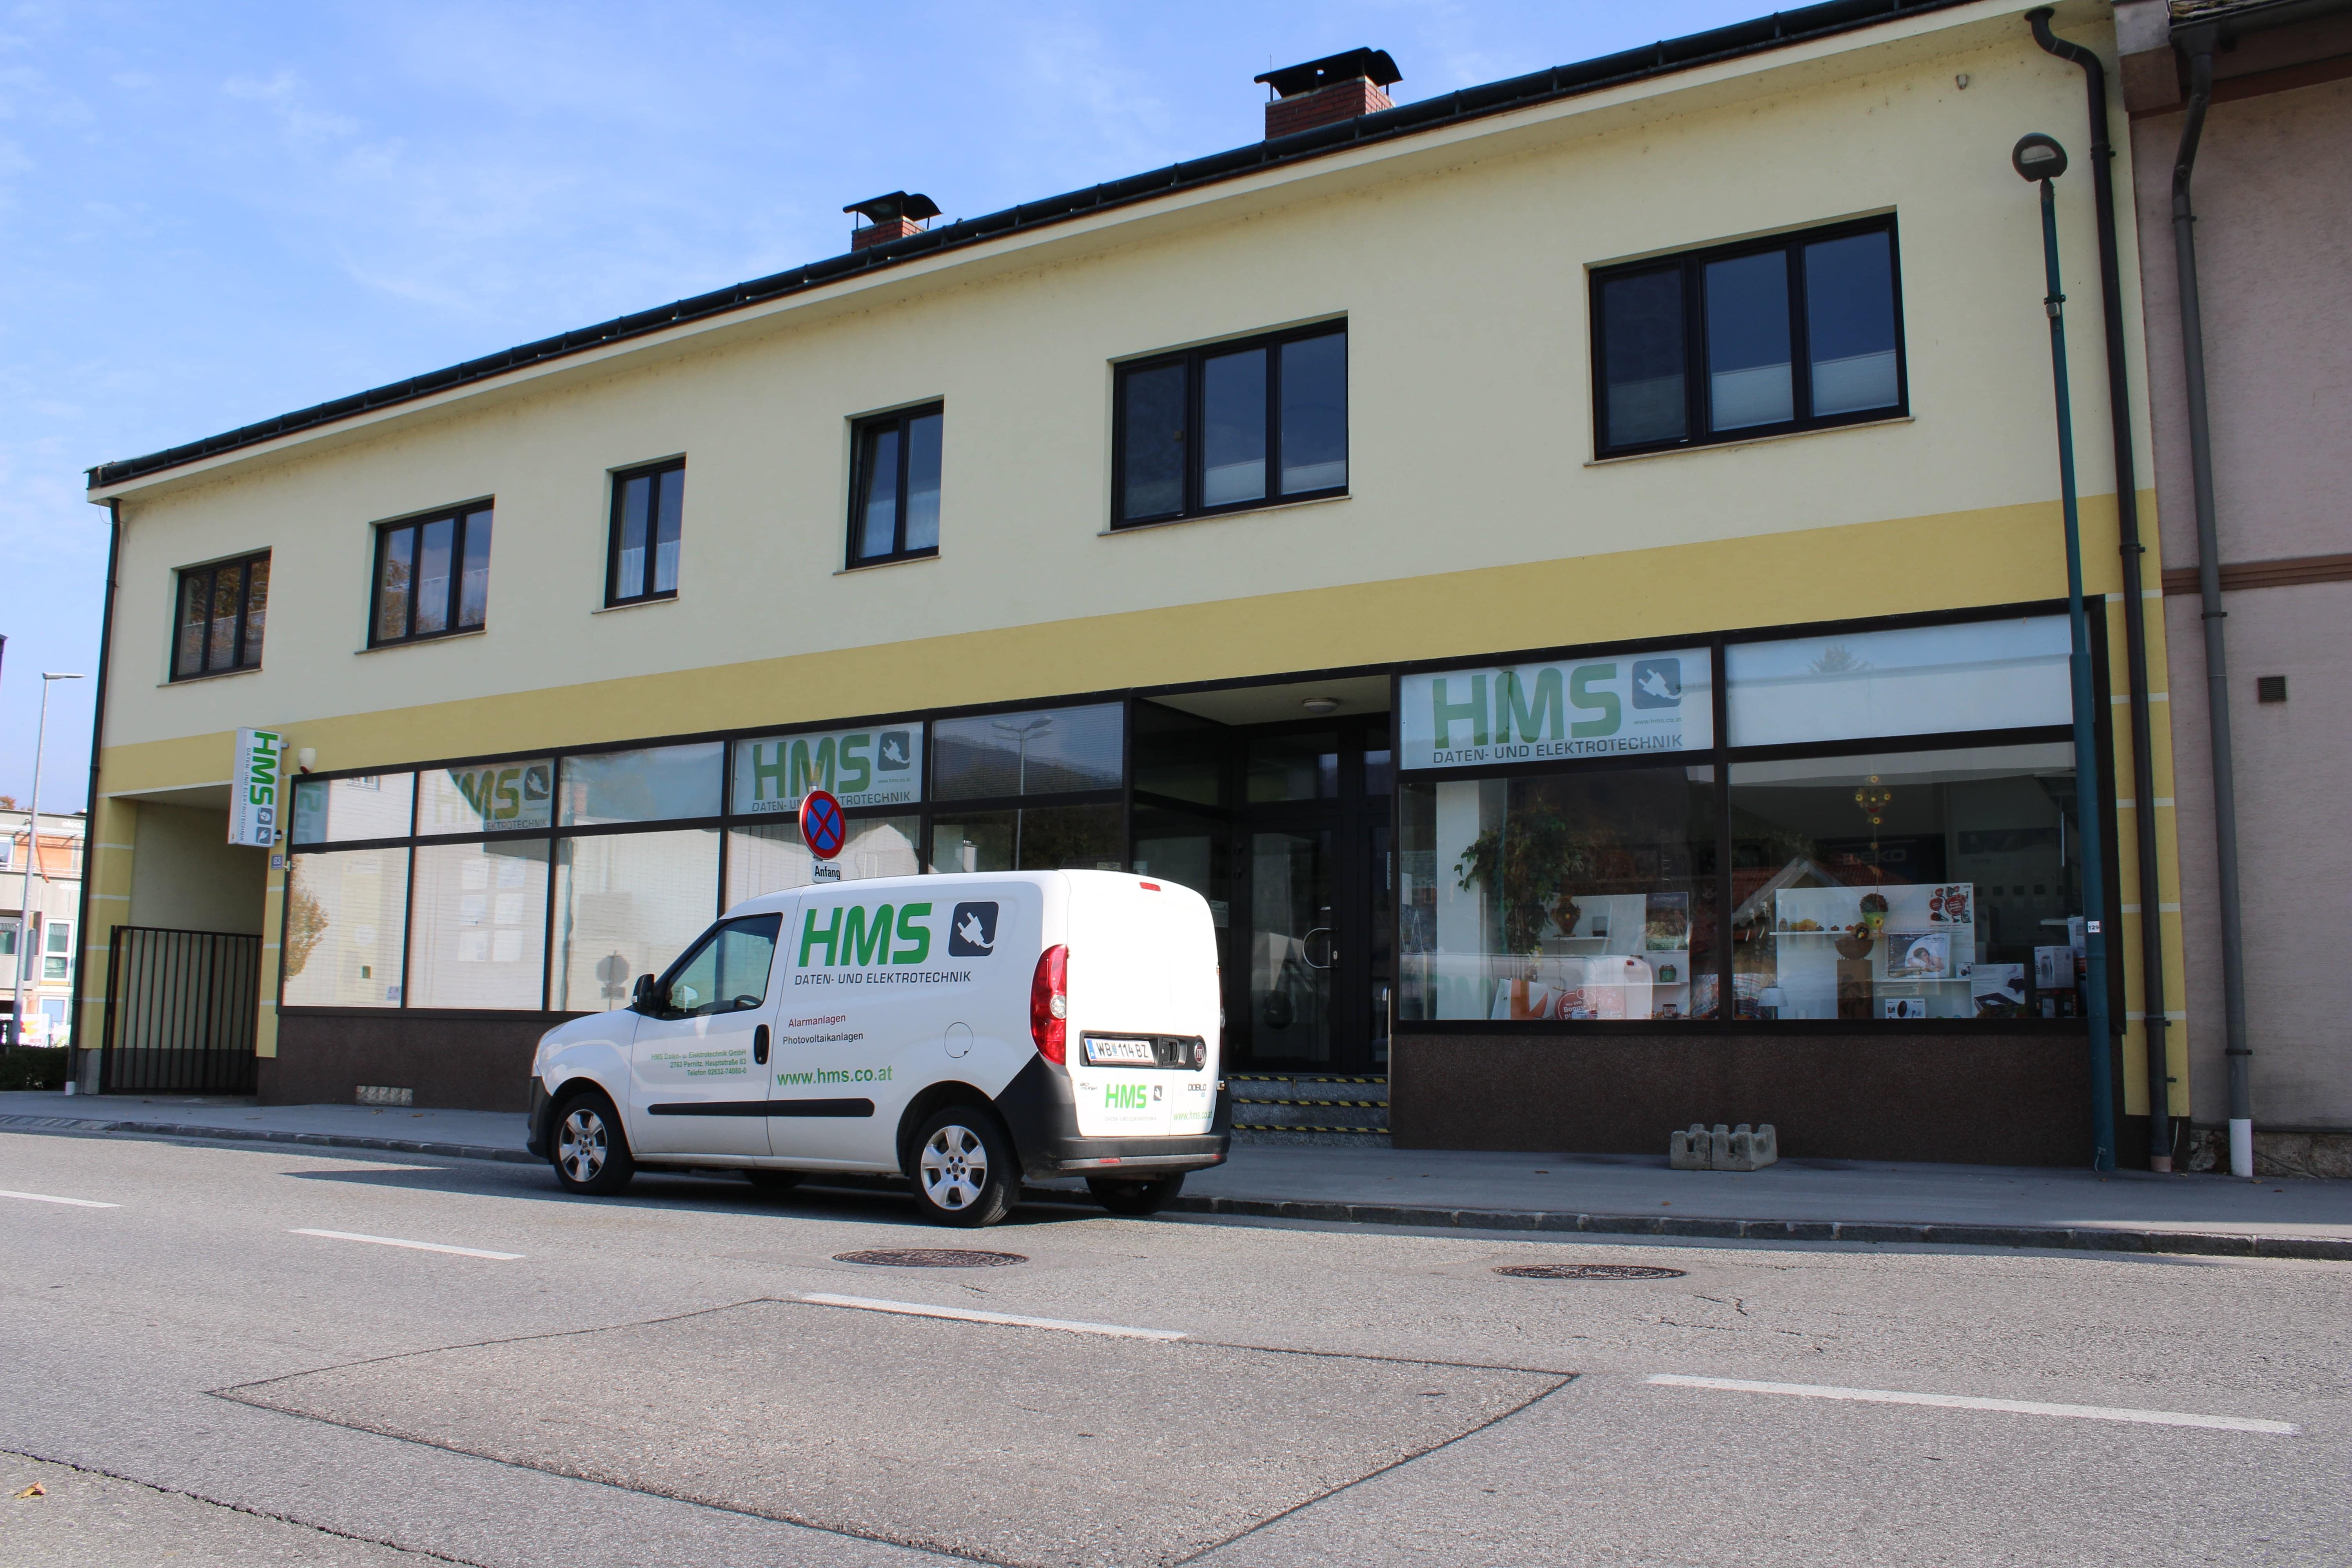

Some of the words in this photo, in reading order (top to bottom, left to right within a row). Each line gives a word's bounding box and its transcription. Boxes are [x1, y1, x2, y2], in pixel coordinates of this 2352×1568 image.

[1433, 663, 1621, 749] HMS
[1433, 749, 1489, 764] DATEN-
[1494, 745, 1530, 759] UND
[1536, 734, 1683, 757] ELEKTROTECHNIK
[249, 731, 279, 805] HMS
[753, 733, 870, 800] HMS
[752, 801, 787, 812] DATEN-
[790, 799, 803, 809] UN
[837, 791, 911, 806] TROTECHNIK
[239, 786, 249, 842] ELEKTROTECHNIK
[273, 857, 281, 865] 83
[815, 865, 841, 880] Anfang
[798, 902, 933, 967] HMS
[795, 973, 834, 985] DATEN-
[838, 973, 862, 984] UND
[867, 970, 971, 984] ELEKTROTECHNIK
[788, 1014, 846, 1028] Alarmanlagen
[783, 1031, 864, 1045] Photovoltaikanlagen
[689, 1050, 727, 1058] Elektrotechnik
[1096, 1042, 1112, 1056] WB
[1118, 1044, 1134, 1058] 114
[1137, 1044, 1149, 1058] BZ
[705, 1059, 738, 1067] Hauptstraße
[708, 1067, 747, 1076] 02632-74080-0
[777, 1065, 893, 1086] www.hms.co.at
[1105, 1084, 1147, 1108] HMS
[1173, 1110, 1212, 1121] www.hms.co.at
